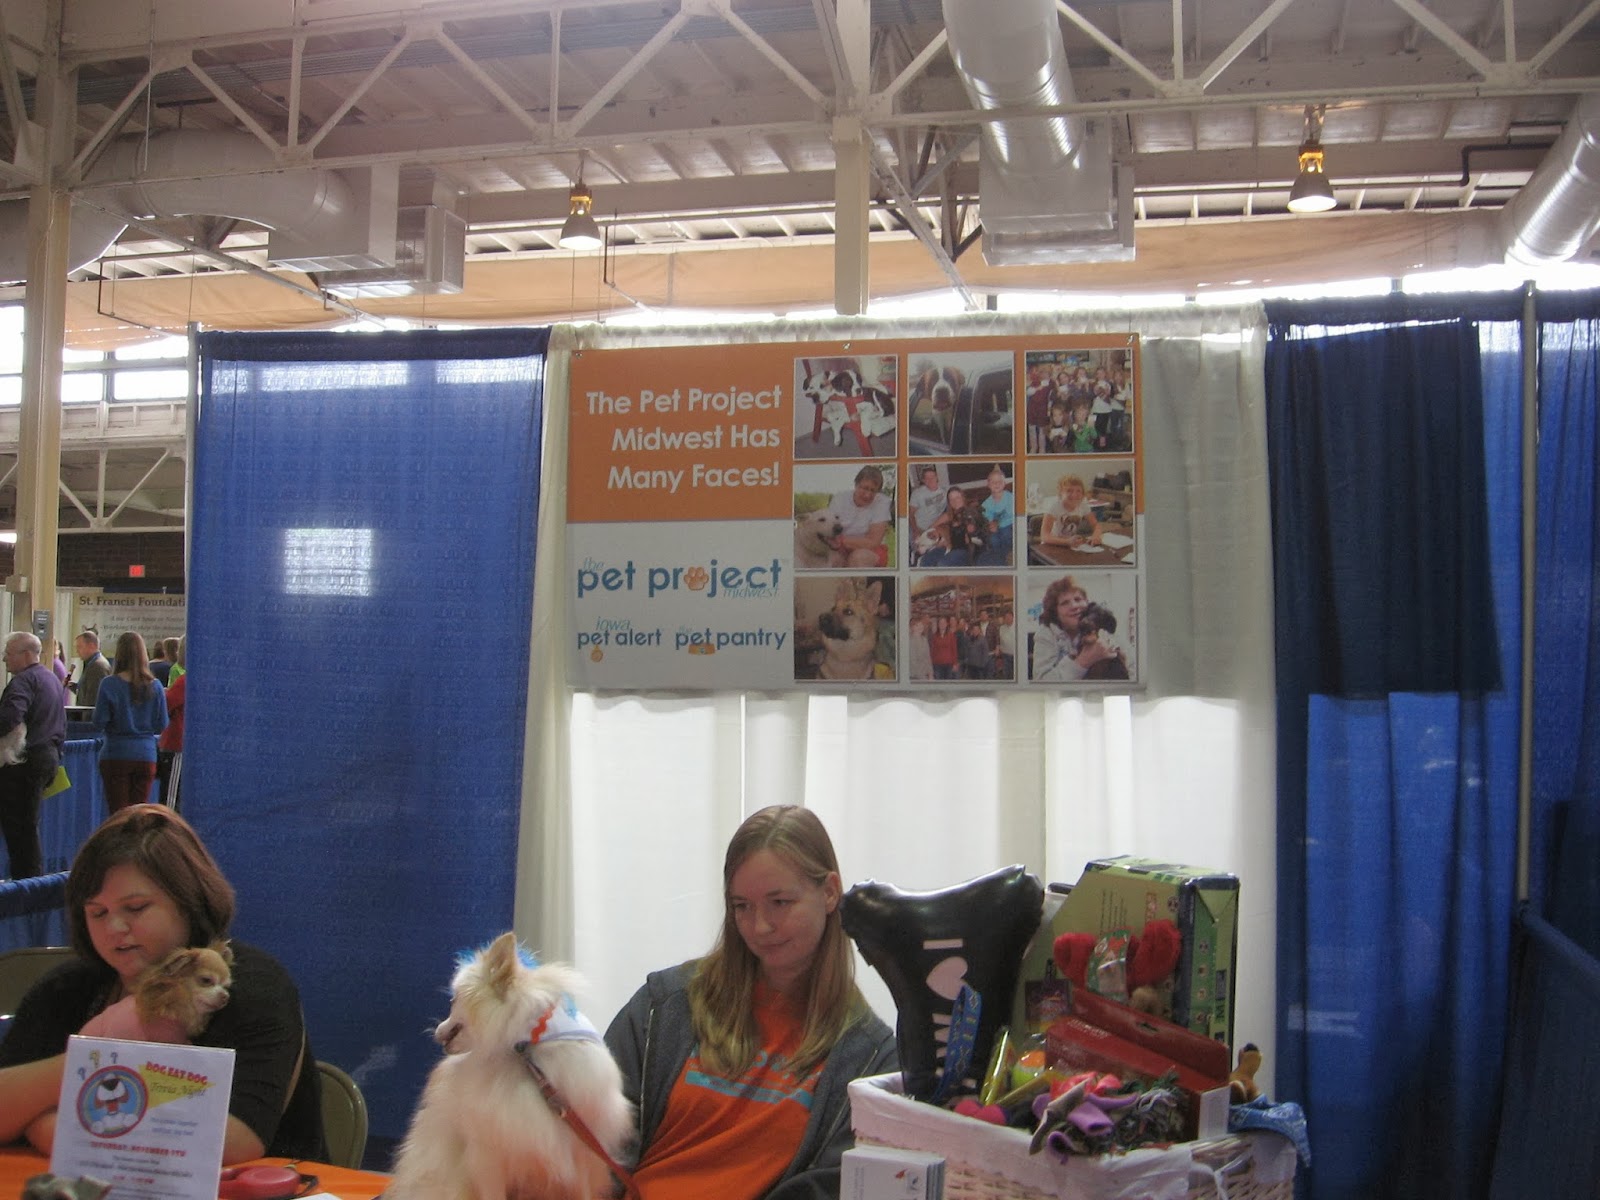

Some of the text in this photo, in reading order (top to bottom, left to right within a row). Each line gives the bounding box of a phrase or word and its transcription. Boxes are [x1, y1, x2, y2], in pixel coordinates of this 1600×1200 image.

[586, 385, 782, 416] The Pet Project
[611, 424, 781, 451] Midwest Has
[607, 462, 779, 493] Many Faces!
[577, 560, 636, 598] pet
[80, 597, 94, 606] St.
[97, 596, 135, 607] Francis
[595, 616, 630, 631] iowa
[577, 628, 661, 650] pet alert
[675, 628, 787, 651] pet pantry
[145, 1061, 167, 1076] DOG
